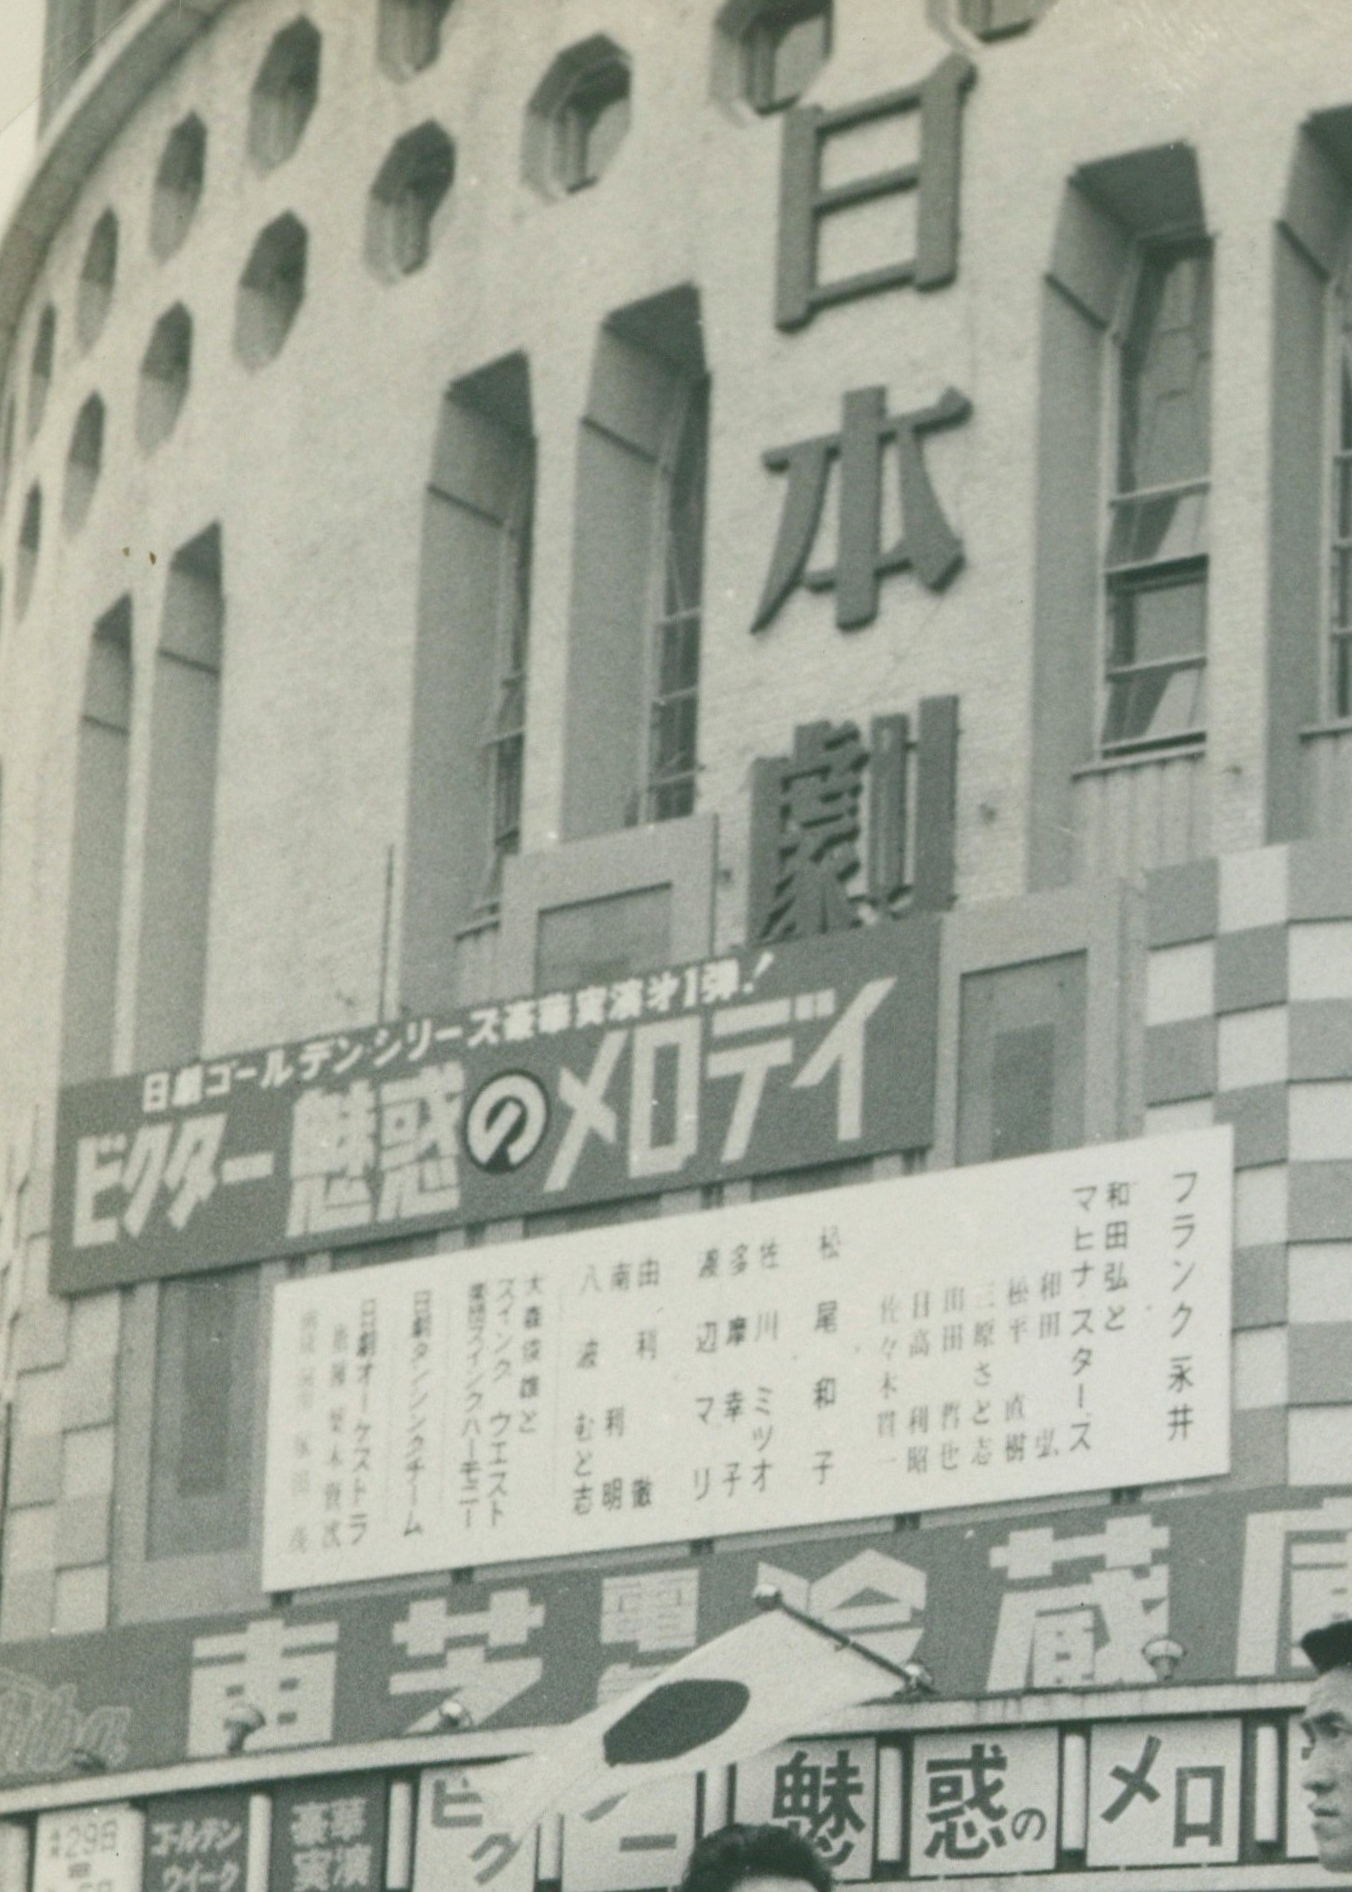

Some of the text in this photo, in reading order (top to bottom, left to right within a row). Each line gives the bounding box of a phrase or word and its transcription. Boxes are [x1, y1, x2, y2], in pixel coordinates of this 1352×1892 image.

[751, 51, 978, 946] 日本劇
[723, 1243, 749, 1499] 多摩幸子
[752, 1239, 780, 1493] 佐川ミツオ
[813, 1225, 843, 1486] 松尾和子
[1103, 1180, 1130, 1332] 和田弘と
[1167, 1171, 1198, 1442] フランク永井
[573, 1263, 602, 1516] 八波むと志
[602, 1260, 632, 1512] 南利明
